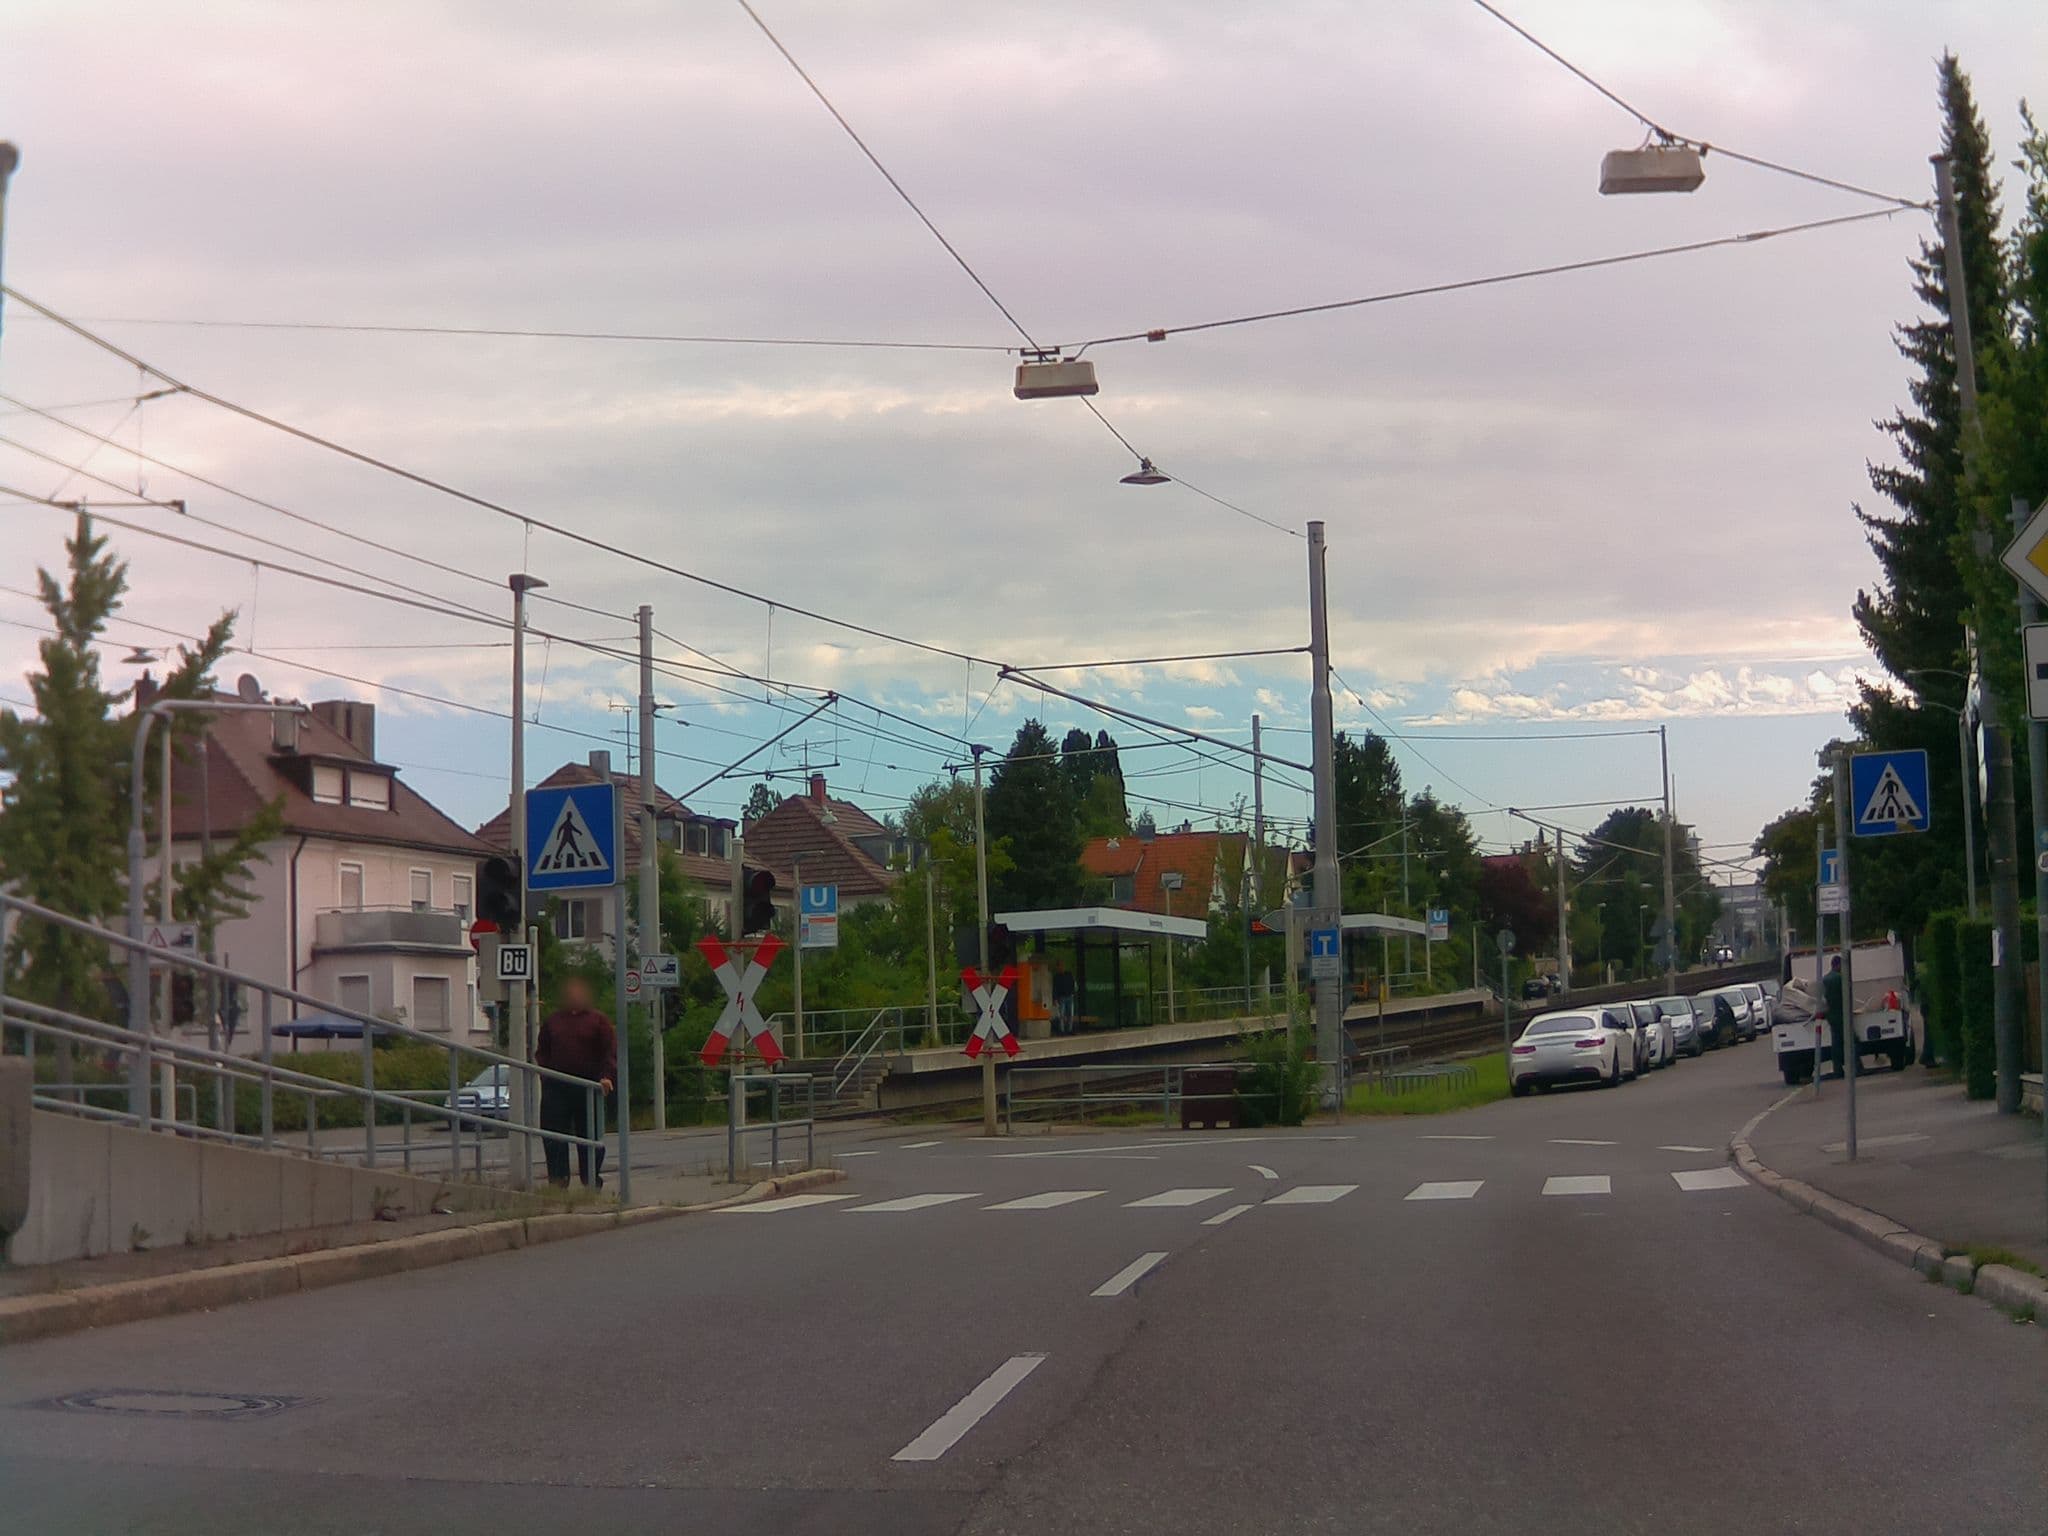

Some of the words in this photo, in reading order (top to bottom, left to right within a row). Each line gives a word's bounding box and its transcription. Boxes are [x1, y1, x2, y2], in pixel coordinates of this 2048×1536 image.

[810, 887, 828, 907] U
[1433, 910, 1444, 921] U
[503, 951, 526, 973] Bü
